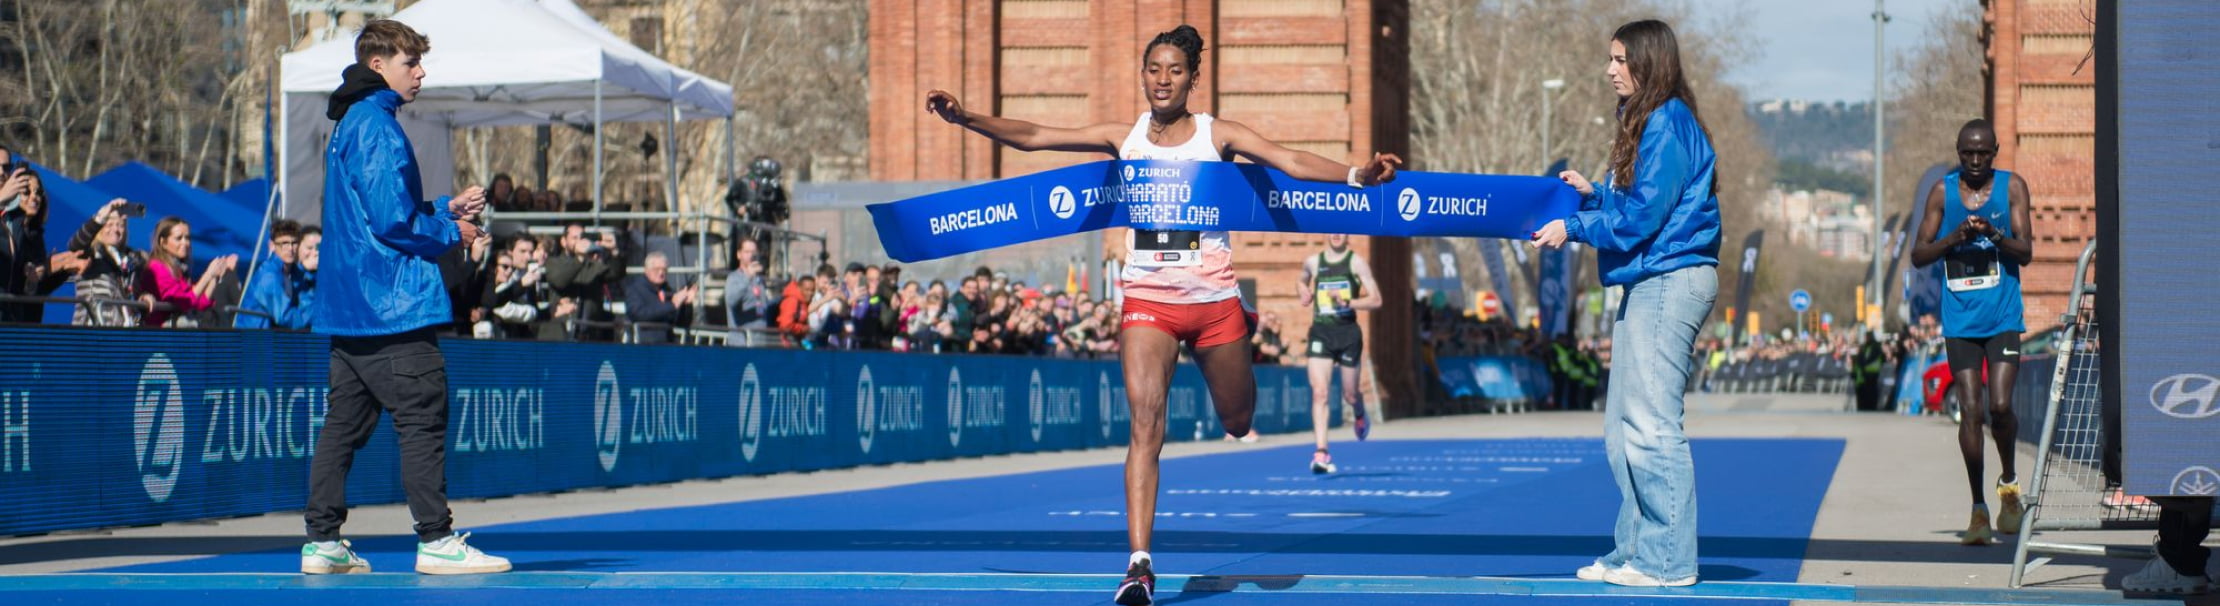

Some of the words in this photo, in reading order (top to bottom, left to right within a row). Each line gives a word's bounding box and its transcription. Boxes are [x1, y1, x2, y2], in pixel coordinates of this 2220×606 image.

[1138, 167, 1180, 178] ZURICH
[929, 202, 1018, 235] BARCELONA
[1129, 204, 1220, 226] BARCELONA
[1268, 190, 1370, 212] BARCELONA
[1427, 196, 1487, 216] ZURICH
[201, 387, 329, 463] ZURICH
[454, 387, 544, 452] ZURICH
[629, 387, 697, 443] ZURICH
[767, 386, 825, 437] ZURICH
[879, 385, 923, 431] ZURICH
[966, 385, 1005, 427] ZURICH
